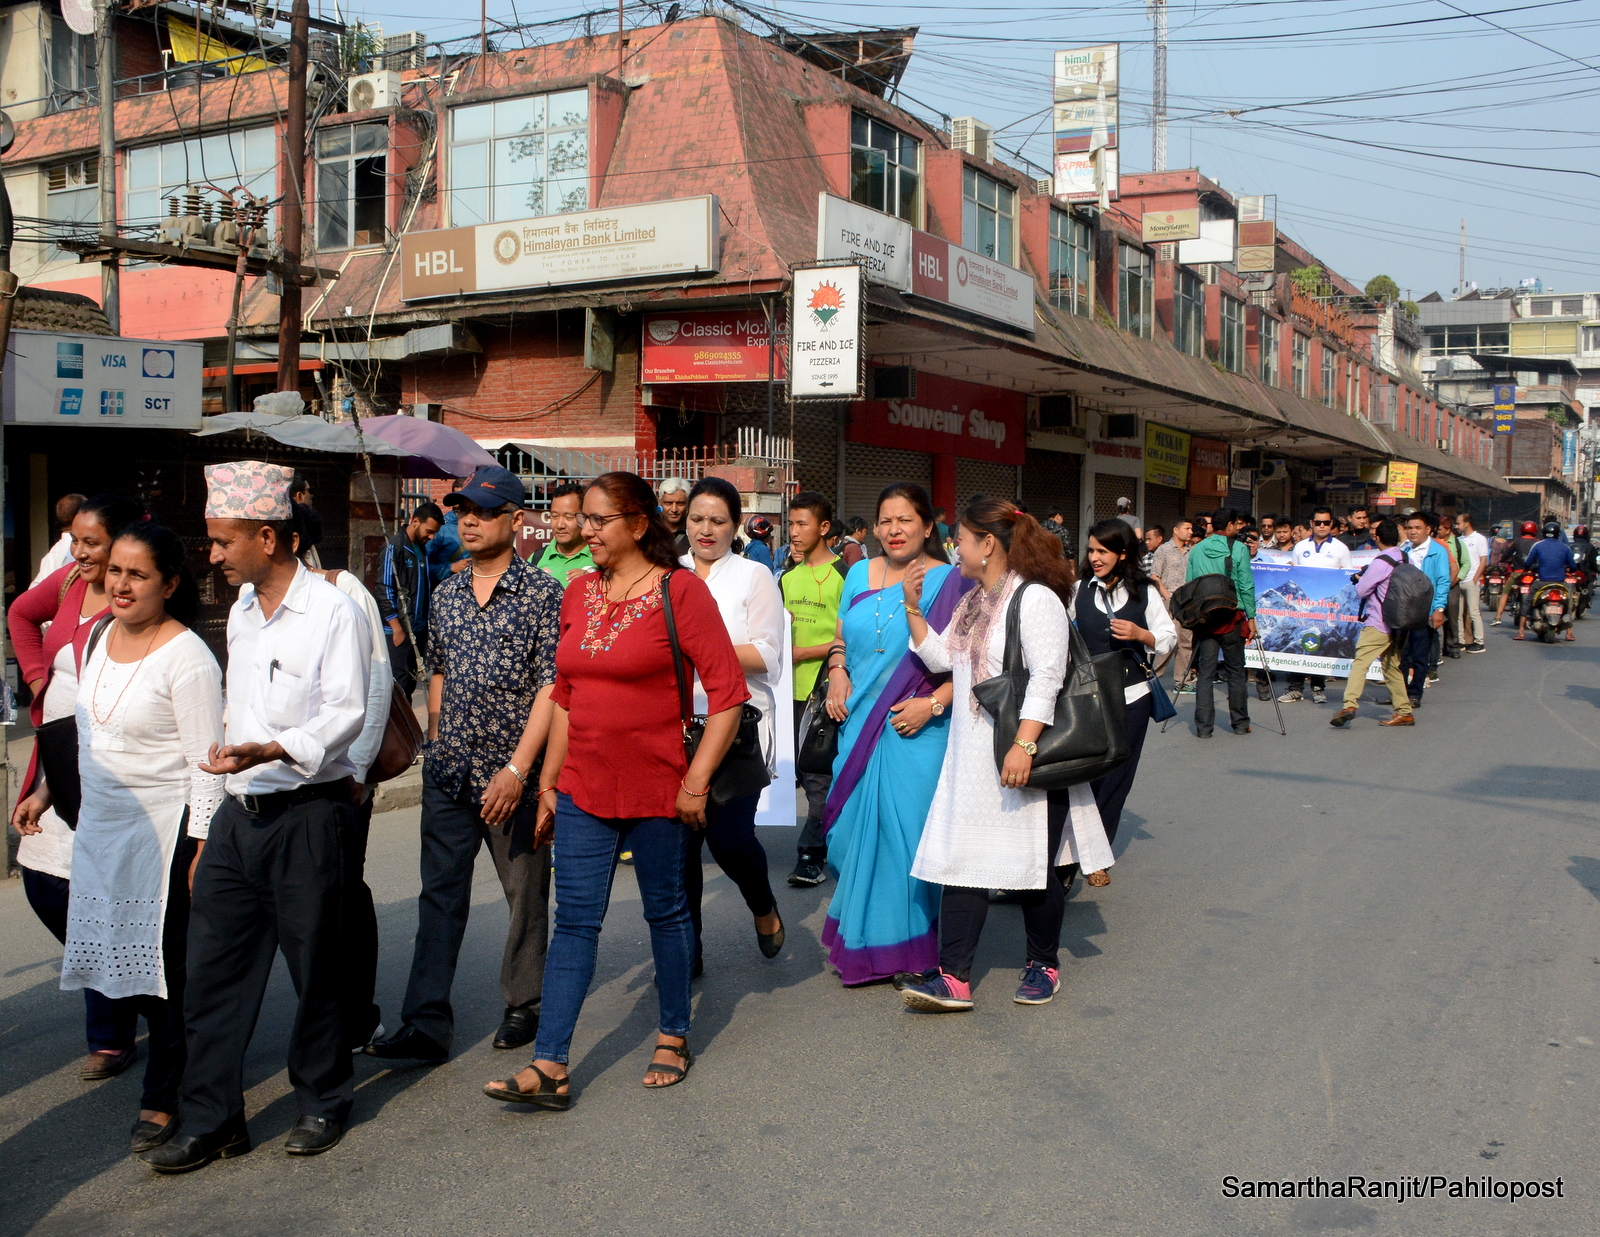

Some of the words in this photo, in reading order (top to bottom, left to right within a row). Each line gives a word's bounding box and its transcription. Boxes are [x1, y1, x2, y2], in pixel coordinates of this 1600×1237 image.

[1064, 53, 1090, 65] himal
[523, 226, 560, 240] हिमालयन
[564, 222, 578, 234] बैंक
[584, 218, 618, 232] लिमिटेड
[524, 238, 580, 252] Himalayan
[583, 232, 610, 246] Bank
[614, 227, 656, 242] Limited
[842, 229, 860, 246] FIRE
[864, 238, 880, 252] AND
[883, 243, 895, 258] ICE
[414, 250, 464, 276] HBL
[918, 252, 943, 282] HBL
[969, 271, 991, 287] Himalayan
[992, 280, 1003, 291] Bank
[1004, 284, 1018, 297] Limited
[809, 314, 822, 327] FIRE
[828, 315, 839, 327] ICE
[681, 320, 732, 337] Classic
[797, 341, 816, 352] FIRE
[819, 340, 837, 350] AND
[840, 339, 853, 349] ICE
[101, 354, 126, 368] VISA
[694, 351, 741, 360] 9869024355
[810, 358, 840, 366] PIZZERIA
[101, 398, 123, 407] JCB
[145, 398, 170, 410] SCT
[888, 400, 965, 435] Souvenir
[968, 409, 1006, 448] Shop
[1155, 431, 1183, 451] MUSKAN
[541, 512, 551, 523] C
[523, 526, 553, 540] Par
[1288, 610, 1324, 619] Sagarmatha
[1302, 660, 1340, 670] Association
